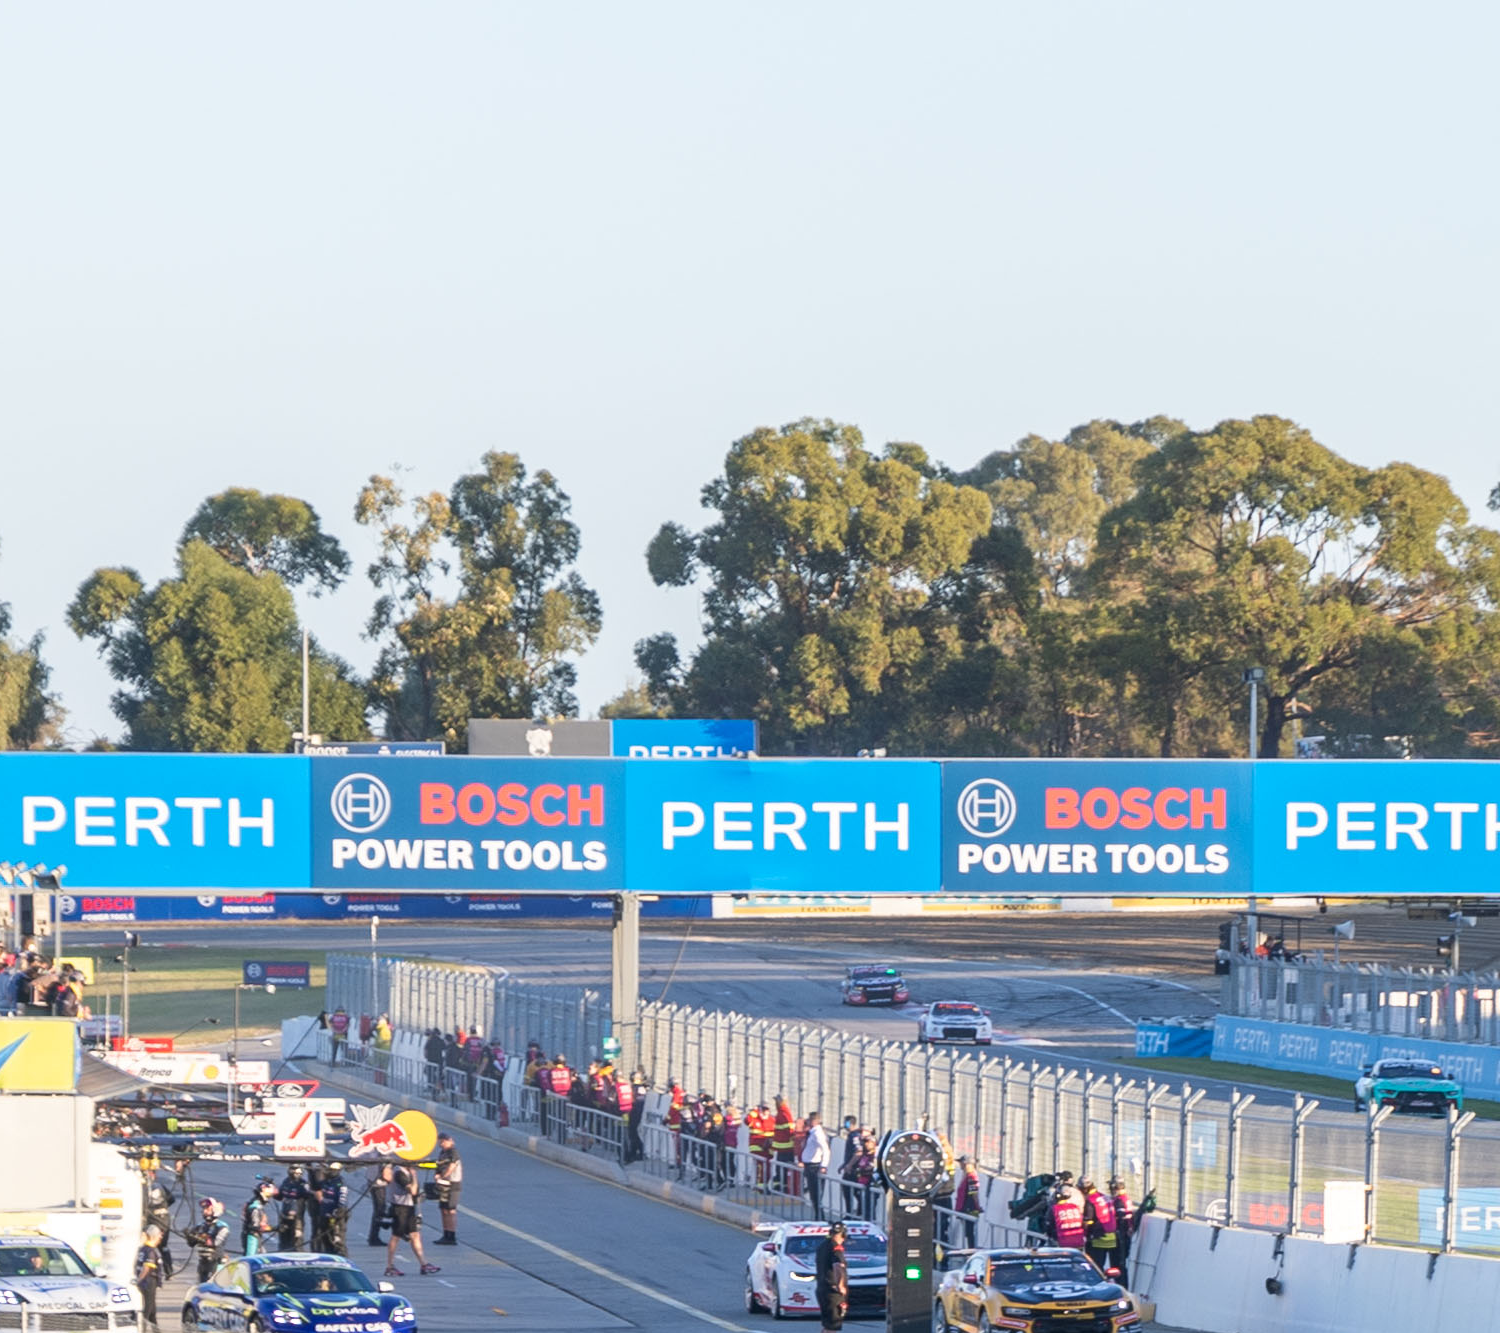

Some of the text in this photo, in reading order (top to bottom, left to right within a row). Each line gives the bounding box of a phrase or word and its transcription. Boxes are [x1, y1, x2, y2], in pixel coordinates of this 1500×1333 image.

[420, 782, 604, 826] BOSCH
[1045, 787, 1227, 830] BOSCH
[22, 795, 276, 848] PERTH
[662, 801, 910, 851] PERTH
[332, 838, 607, 871] POWER TOOLS
[958, 843, 1229, 875] POWER TOOLS
[81, 897, 134, 912] BOSCH
[222, 905, 249, 914] POWER
[1136, 1031, 1170, 1053] RTH
[1234, 1028, 1270, 1053] PERTH
[1278, 1033, 1320, 1061] PERTH
[1329, 1039, 1370, 1067] PERTH
[279, 1145, 319, 1153] AMPOL
[1249, 1203, 1324, 1226] BOC
[37, 1301, 86, 1311] MEDICAL
[334, 1307, 379, 1316] pulse
[315, 1323, 363, 1332] SAFETY
